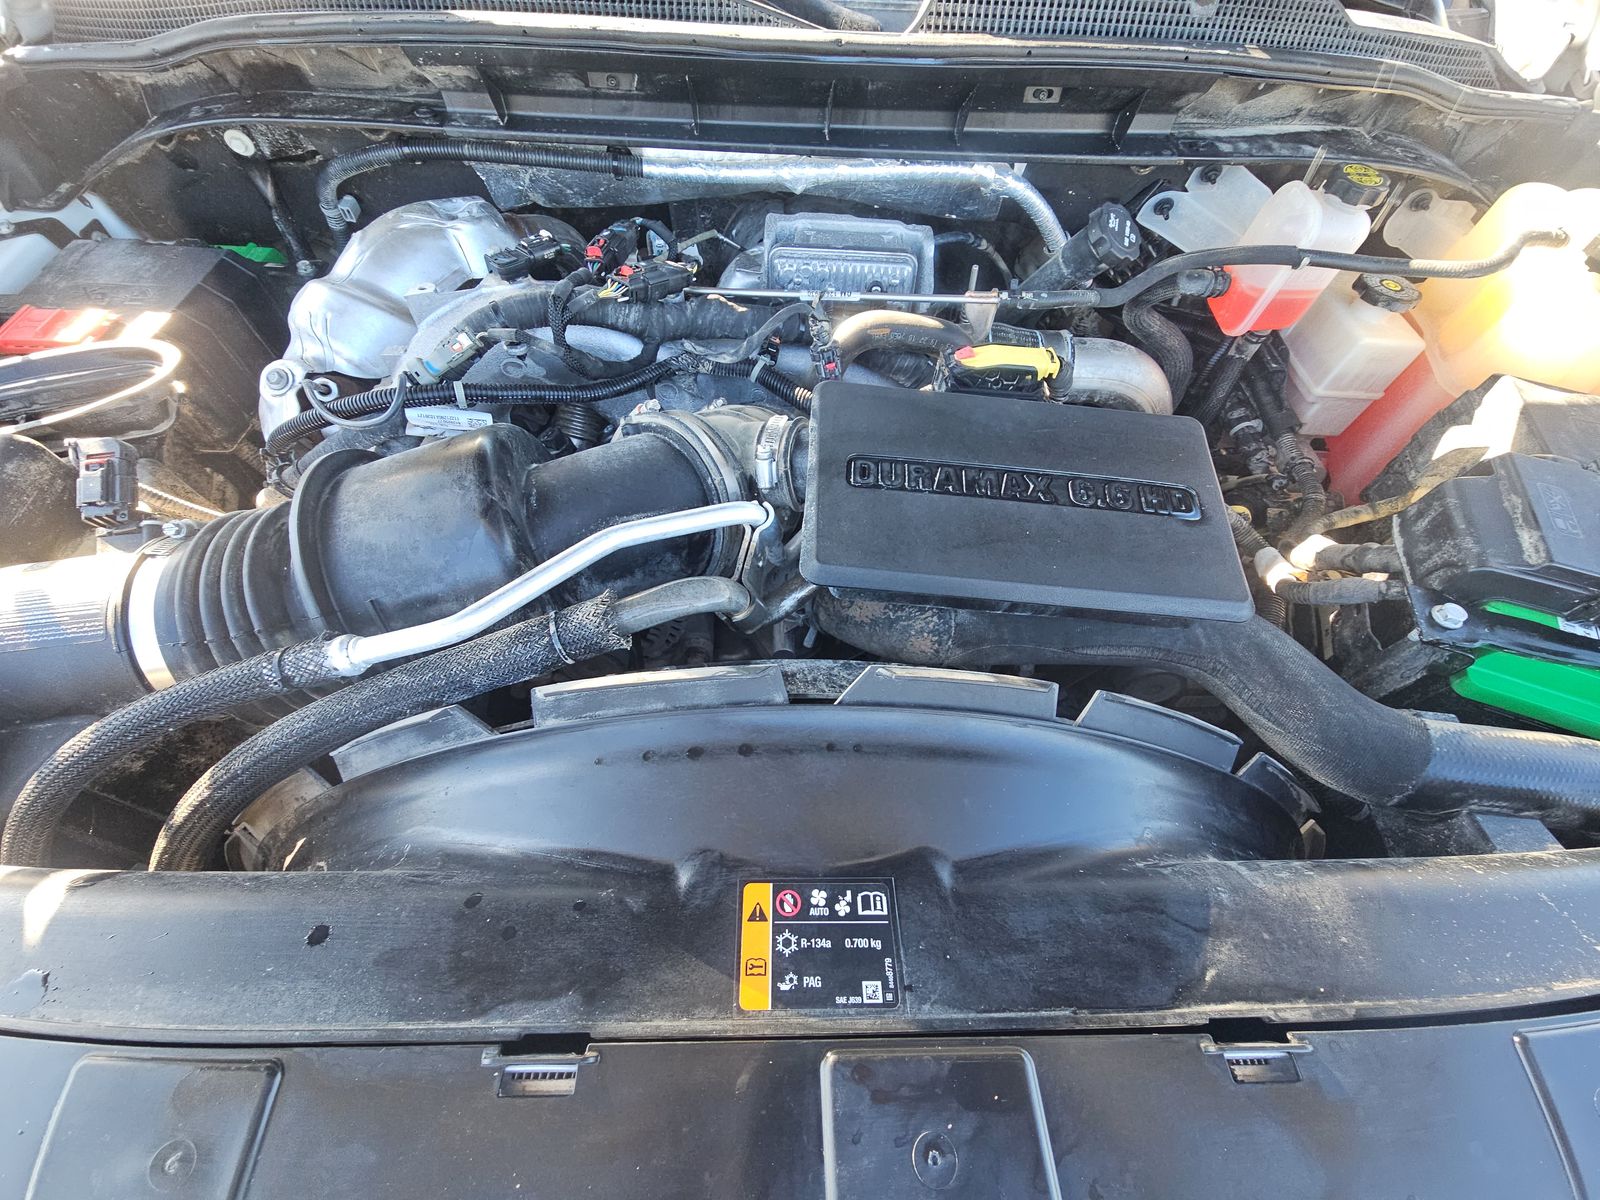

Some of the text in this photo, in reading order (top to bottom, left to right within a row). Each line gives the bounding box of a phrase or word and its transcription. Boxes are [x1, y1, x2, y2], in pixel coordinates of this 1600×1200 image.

[850, 459, 1195, 515] DURAMAX 6.6 HD
[809, 907, 830, 916] AUTO
[800, 938, 882, 950] R-134a 0.700 kg
[803, 976, 822, 988] PAG
[835, 996, 848, 1004] SAE
